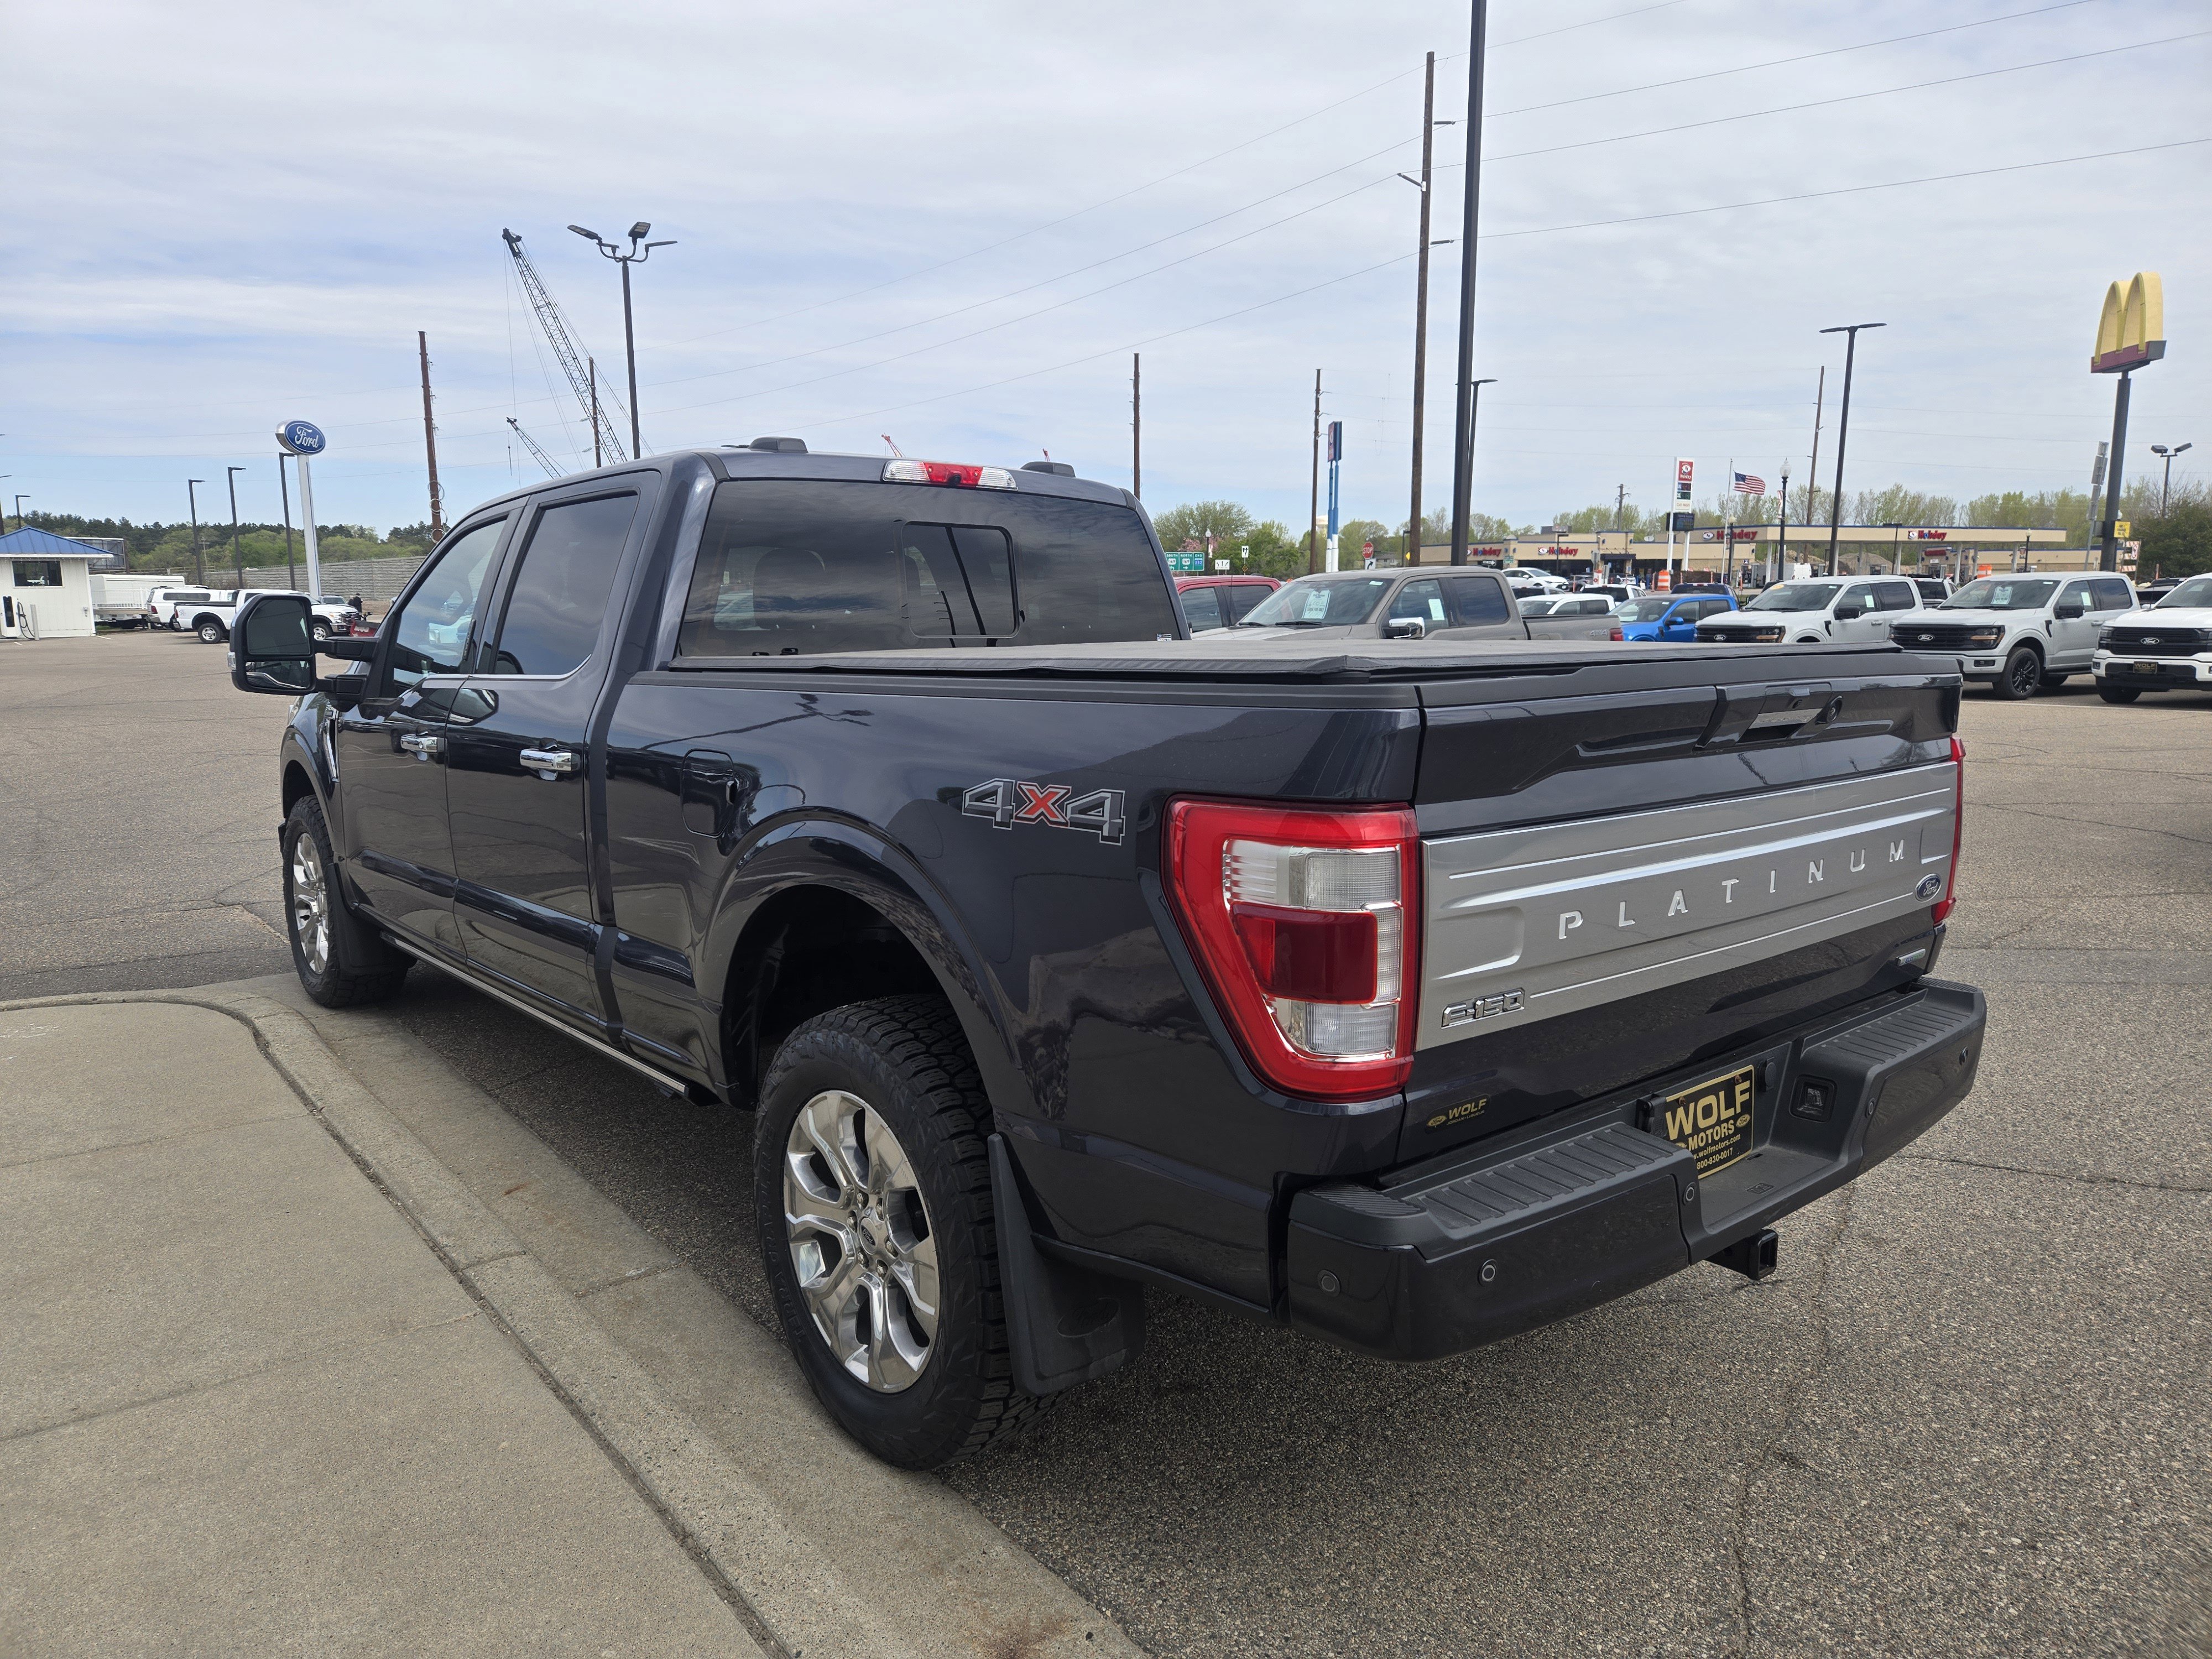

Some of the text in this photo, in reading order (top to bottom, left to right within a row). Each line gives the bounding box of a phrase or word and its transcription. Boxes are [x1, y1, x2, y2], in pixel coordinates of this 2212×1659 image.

[295, 426, 319, 448] Ford
[1558, 838, 1905, 940] PLATINUM
[1923, 879, 1938, 896] Ford
[1441, 987, 1525, 1029] F-150
[1448, 1098, 1486, 1119] WOLF
[1666, 1080, 1750, 1140] WOLF
[1688, 1119, 1734, 1151] MOTORS
[1697, 1147, 1733, 1170] 800-830-0017
[863, 1229, 873, 1244] Ford
